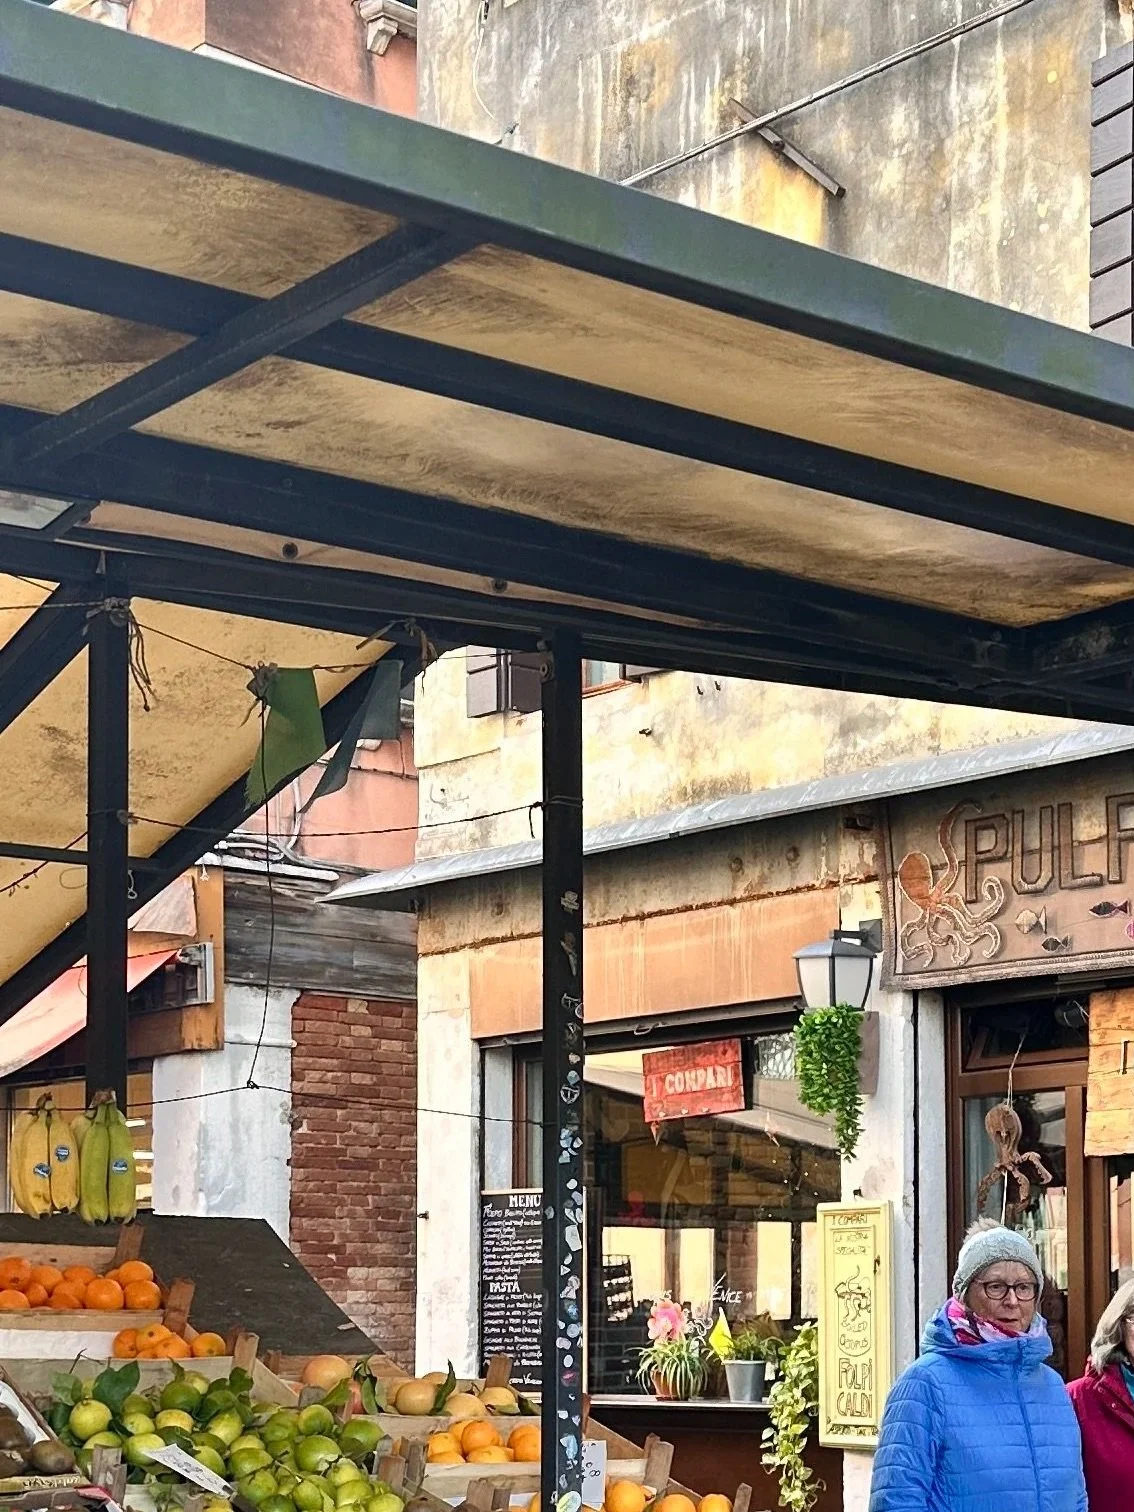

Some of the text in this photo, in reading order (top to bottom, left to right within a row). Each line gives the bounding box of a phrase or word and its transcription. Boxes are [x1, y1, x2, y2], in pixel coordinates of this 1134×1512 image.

[1121, 1040, 1130, 1075] I
[650, 1065, 734, 1097] I COMPARI
[508, 1194, 541, 1207] MENU
[489, 1281, 520, 1292] PASTA
[711, 1271, 742, 1304] VENICE
[836, 1391, 873, 1418] CALDI
